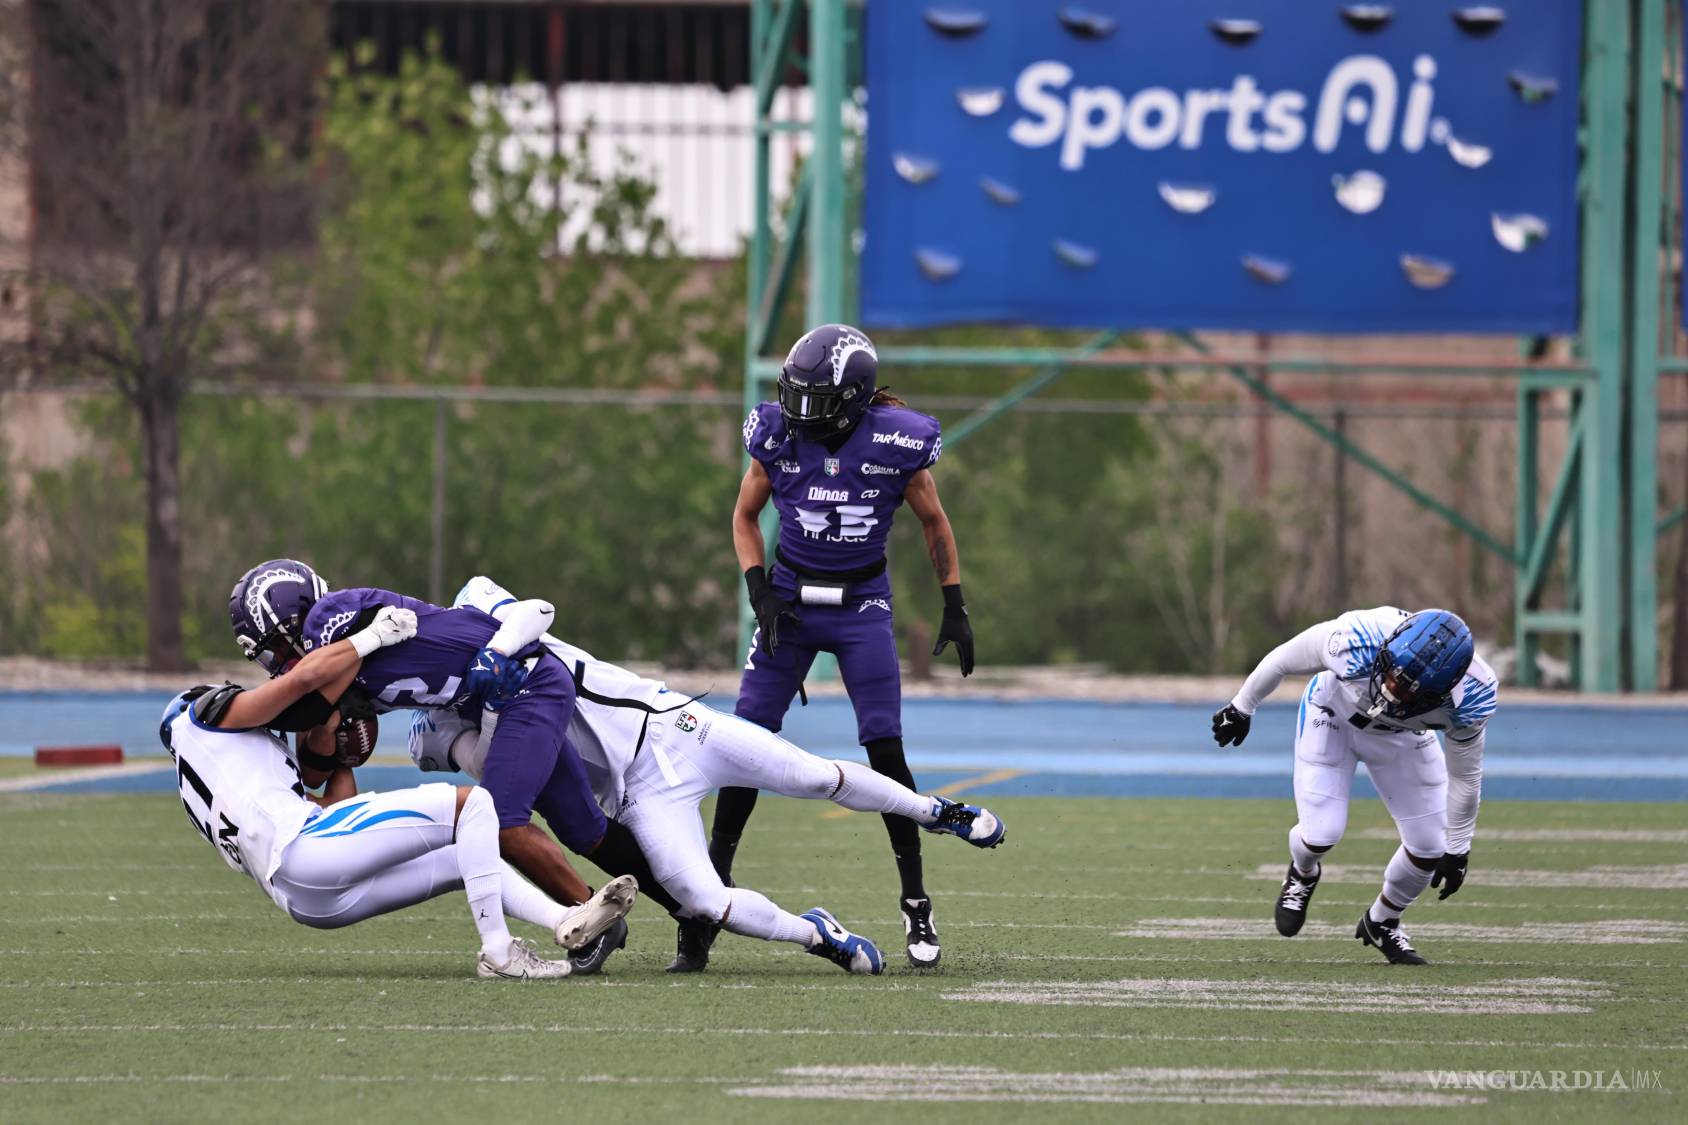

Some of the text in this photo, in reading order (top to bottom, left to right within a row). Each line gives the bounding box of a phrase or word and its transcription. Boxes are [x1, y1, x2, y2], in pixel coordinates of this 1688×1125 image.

[872, 432, 924, 451] TAR MÉXICO
[807, 486, 848, 501] Dinos
